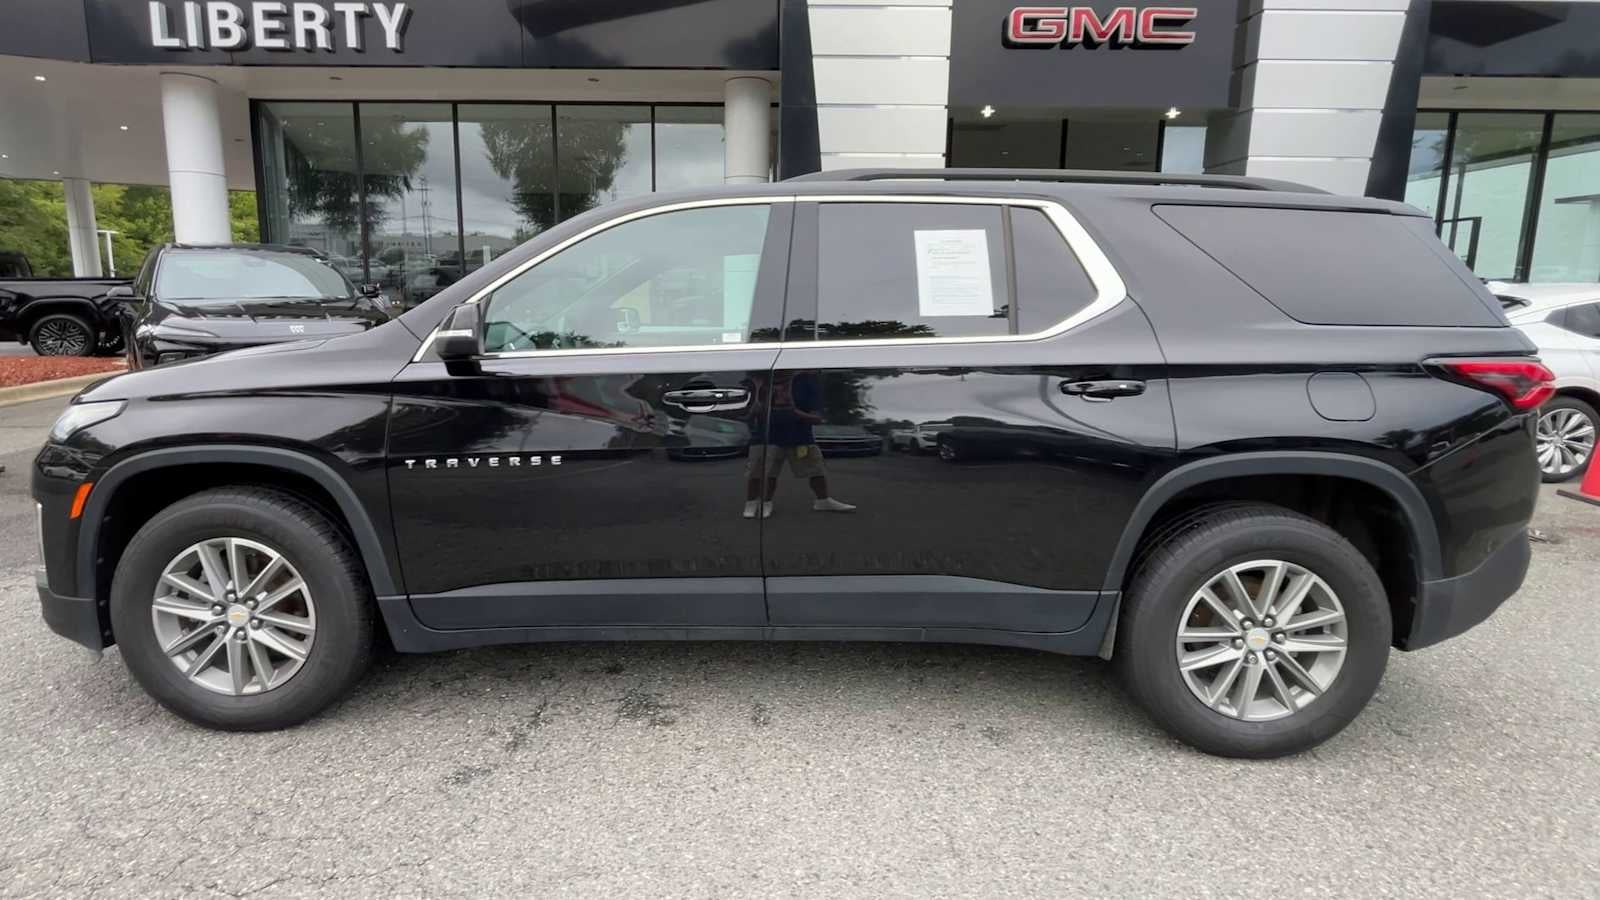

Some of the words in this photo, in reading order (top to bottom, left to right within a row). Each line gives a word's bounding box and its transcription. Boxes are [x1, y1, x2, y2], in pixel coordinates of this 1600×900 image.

[149, 1, 407, 49] LIBERTY
[1008, 7, 1198, 43] GMC
[405, 455, 562, 469] TRAVERSE
